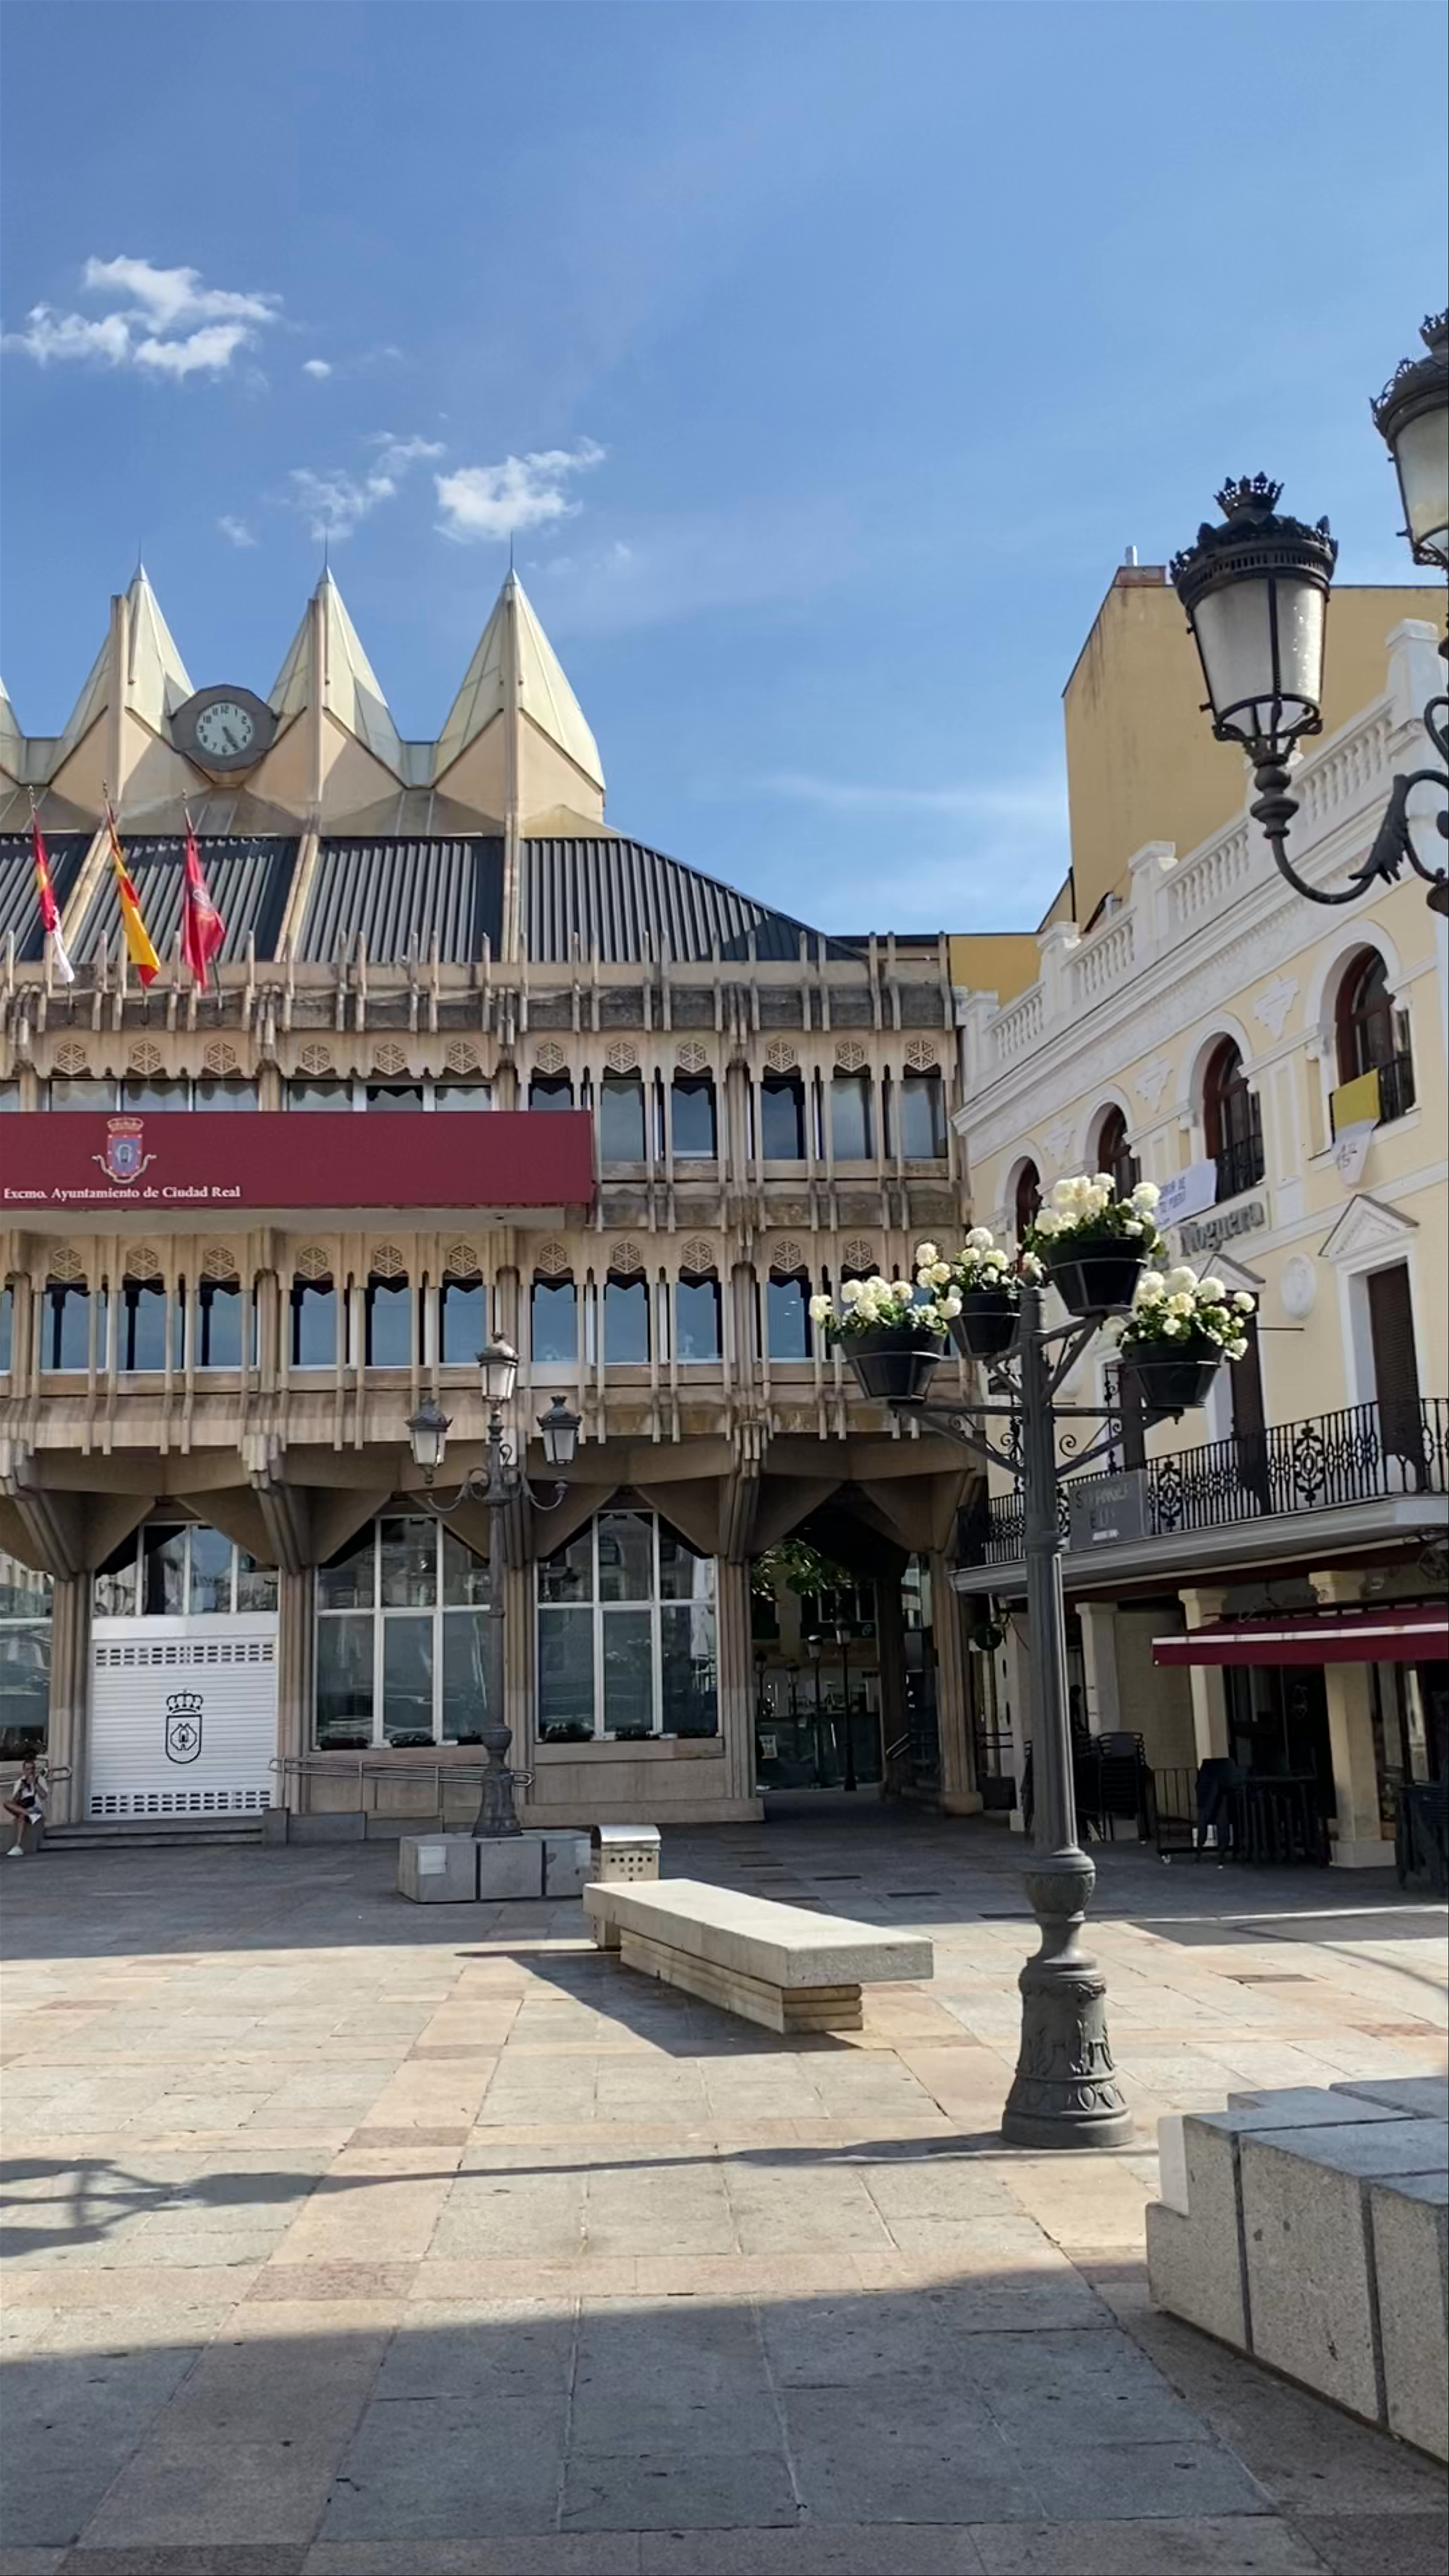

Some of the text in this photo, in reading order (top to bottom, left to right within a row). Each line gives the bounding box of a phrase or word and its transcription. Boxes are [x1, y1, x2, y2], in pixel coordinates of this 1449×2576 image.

[213, 707, 218, 717] 11
[221, 705, 229, 714] 12
[203, 715, 212, 724] 10
[241, 715, 246, 724] 2
[198, 725, 204, 734] 9
[246, 725, 251, 734] 3
[203, 735, 208, 743] 8
[212, 742, 217, 751] 7
[222, 745, 227, 754] 6
[4, 1186, 241, 1201] Excmo. Ayuntamiento de Ciudad Real
[1179, 1201, 1264, 1257] Noguera
